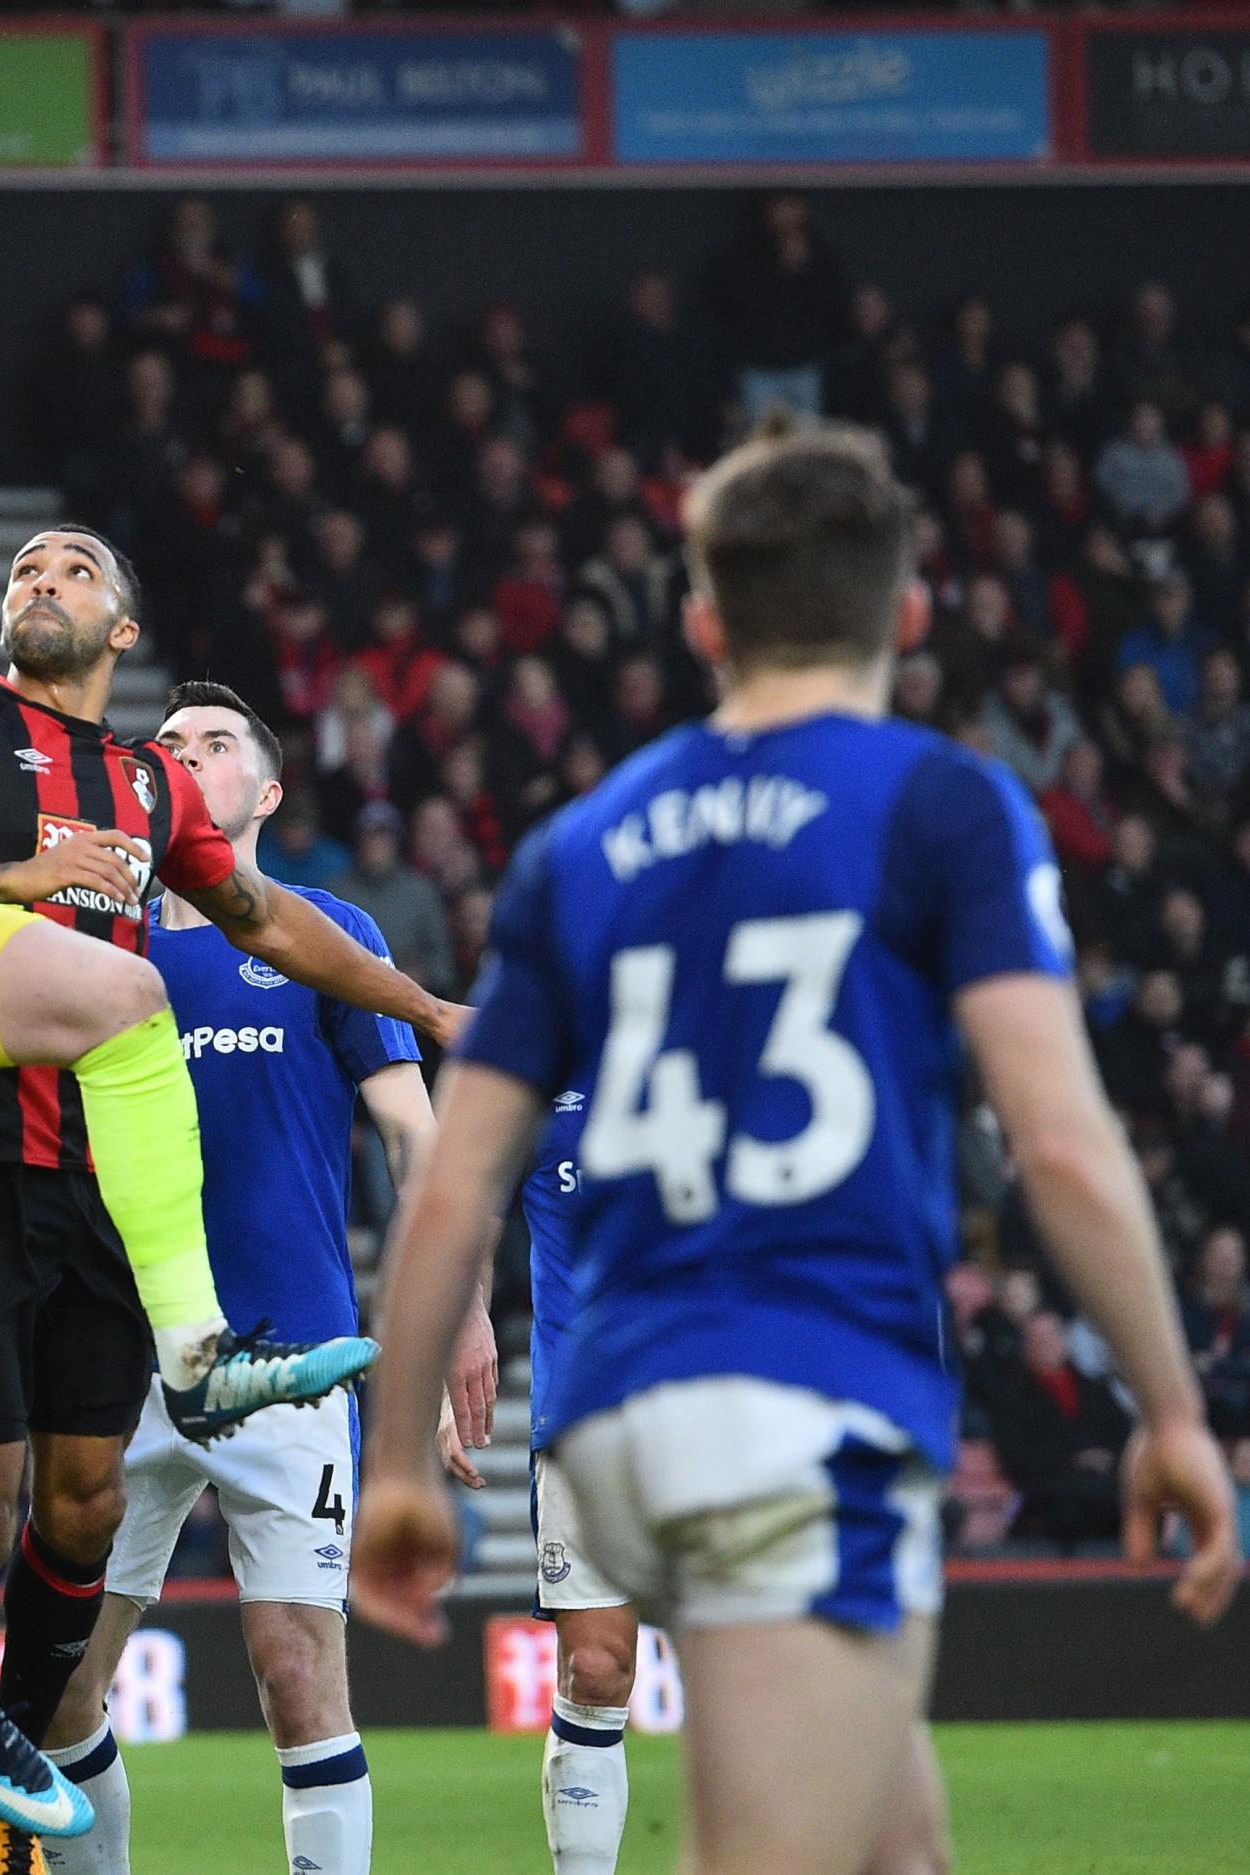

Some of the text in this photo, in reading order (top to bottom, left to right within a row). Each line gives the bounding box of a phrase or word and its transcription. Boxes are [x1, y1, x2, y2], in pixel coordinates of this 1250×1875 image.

[181, 1026, 285, 1060] tPesa
[580, 909, 876, 1226] 43
[555, 1104, 583, 1113] umbro
[312, 1464, 347, 1536] 4
[317, 1559, 343, 1571] umbro
